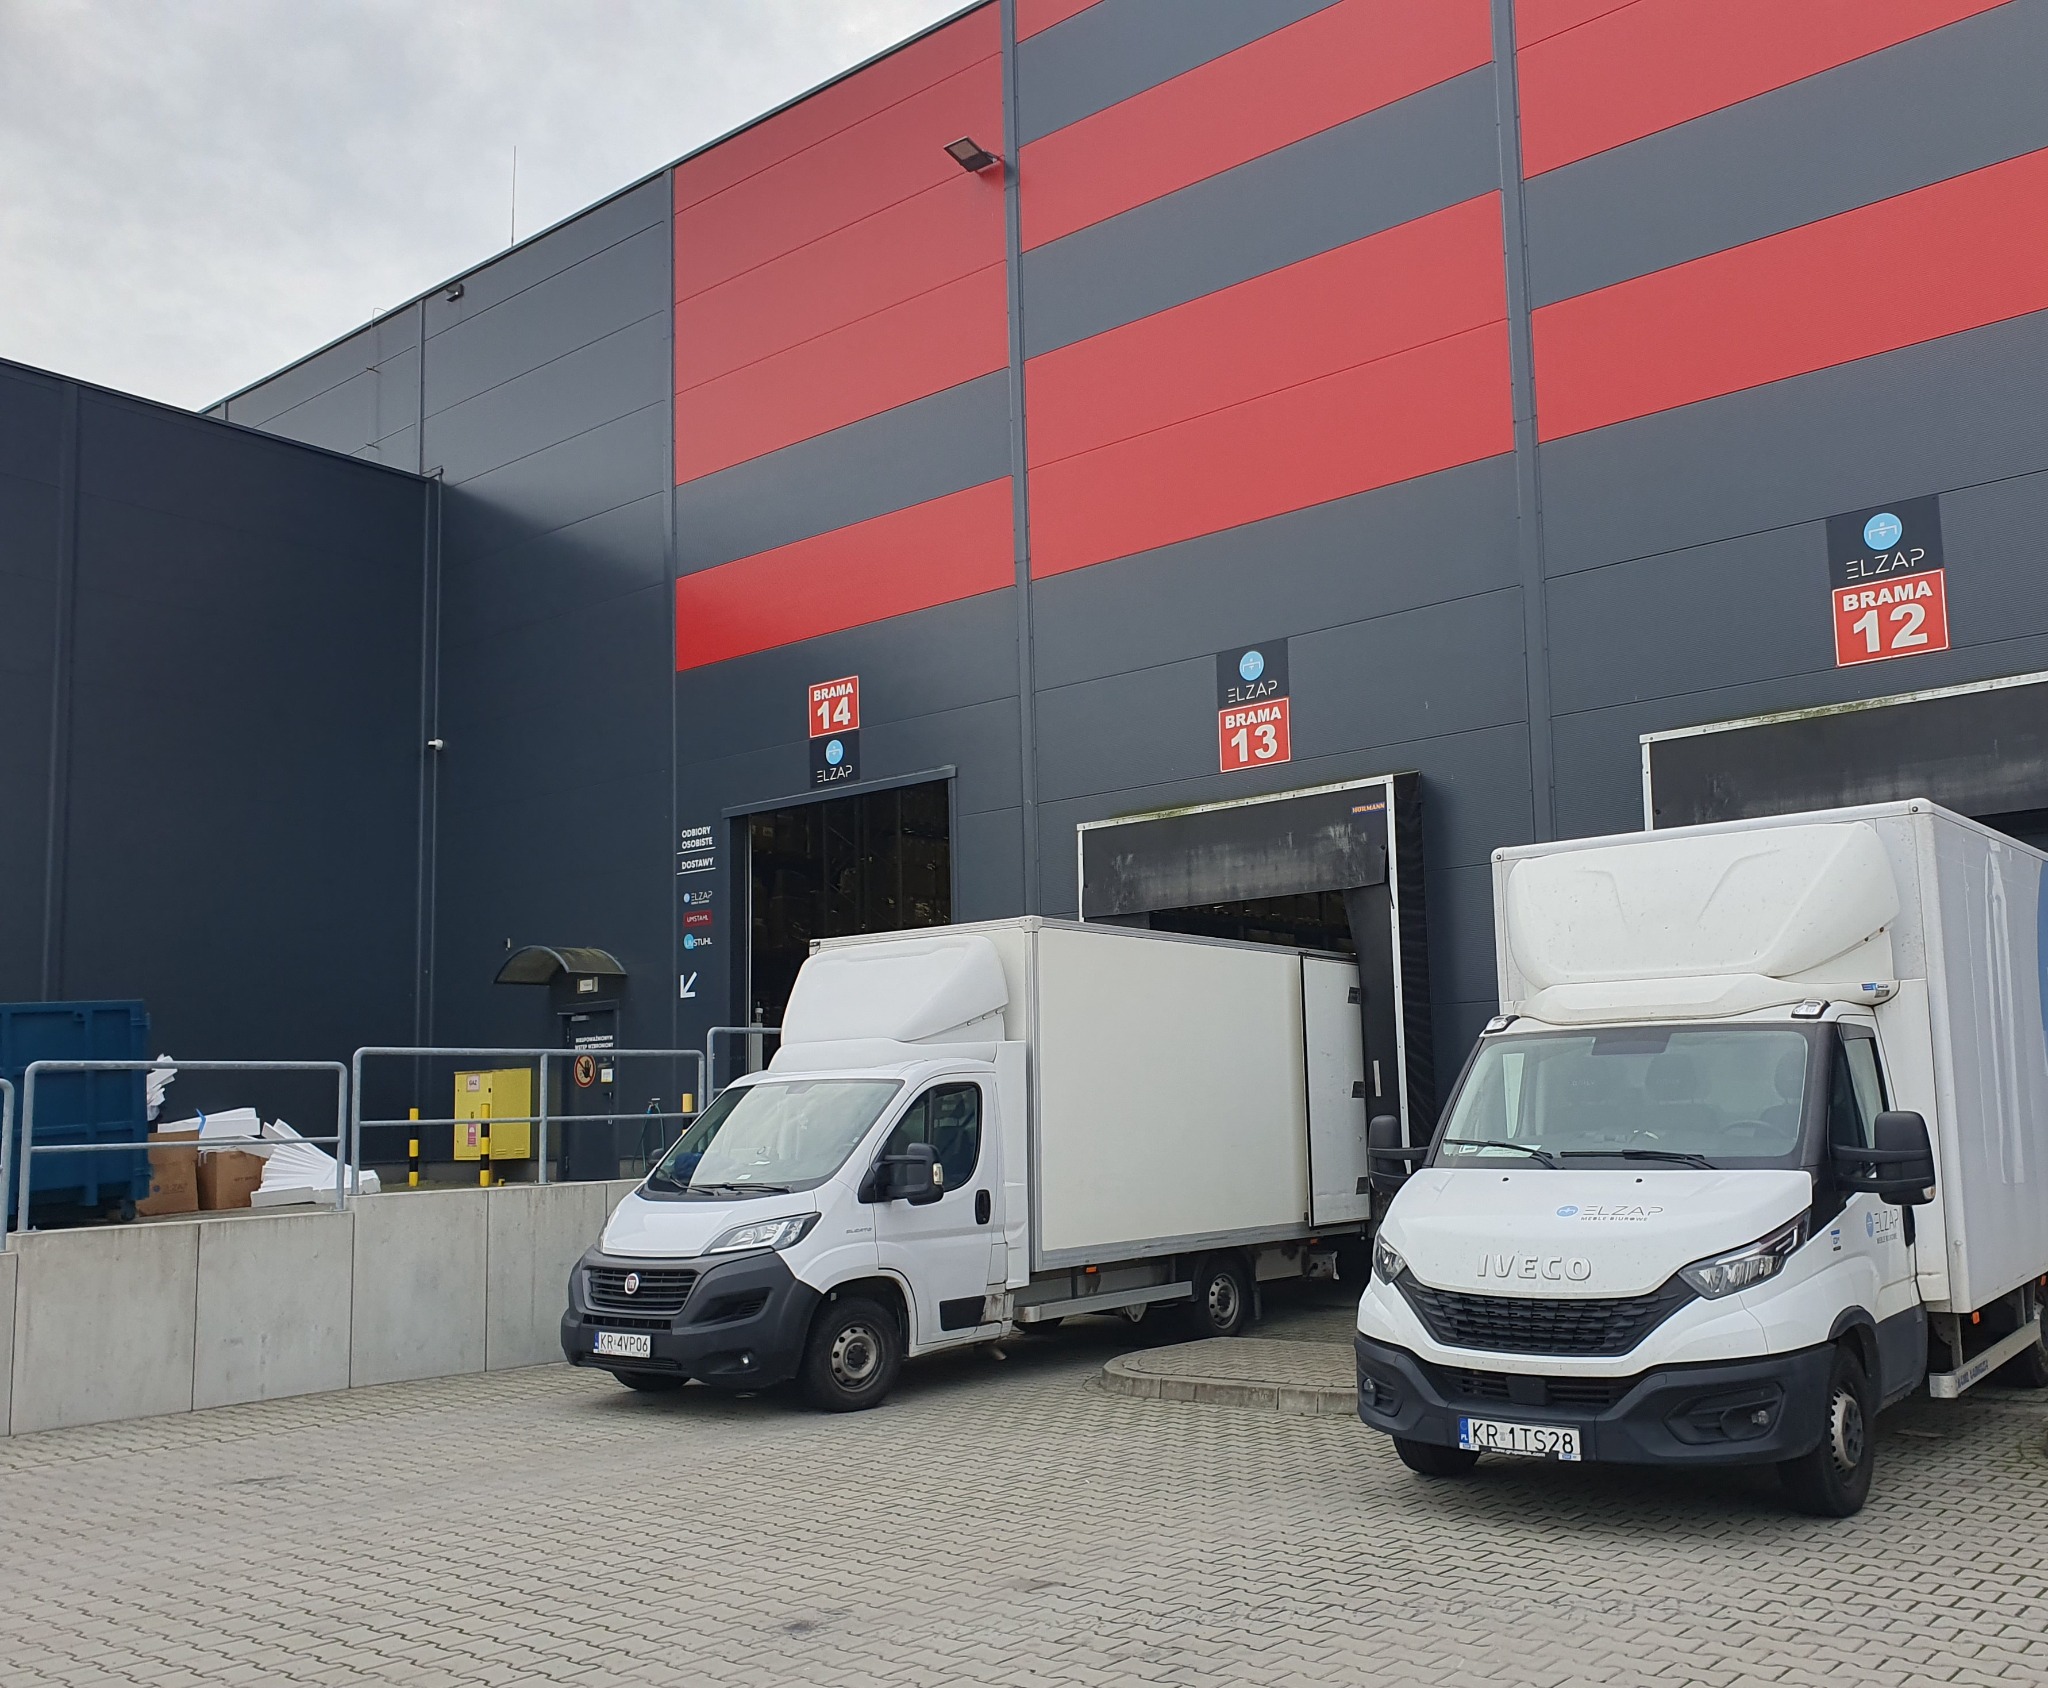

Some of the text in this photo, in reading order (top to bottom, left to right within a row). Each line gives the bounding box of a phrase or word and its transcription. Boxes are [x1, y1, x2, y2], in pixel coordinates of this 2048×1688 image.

[1846, 548, 1925, 580] ELZAP
[1843, 580, 1933, 612] BRAMA
[1853, 603, 1928, 654] 12
[813, 682, 854, 702] BRAMA
[1227, 679, 1278, 703] ELZAP
[817, 696, 851, 730] 14
[1225, 706, 1282, 729] BRAMA
[1230, 724, 1278, 763] 13
[816, 764, 853, 783] ELZAP
[681, 825, 711, 839] ODBIORY
[681, 836, 713, 850] OSOBISTE
[681, 857, 714, 870] DOSTAWY
[691, 890, 713, 902] ELZAP
[1583, 1205, 1664, 1216] ELZAP
[1874, 1208, 1899, 1234] ELZAP
[1477, 1253, 1592, 1281] IVECO
[600, 1334, 648, 1352] KR 4VP06
[1472, 1421, 1574, 1454] KR 1TS28
